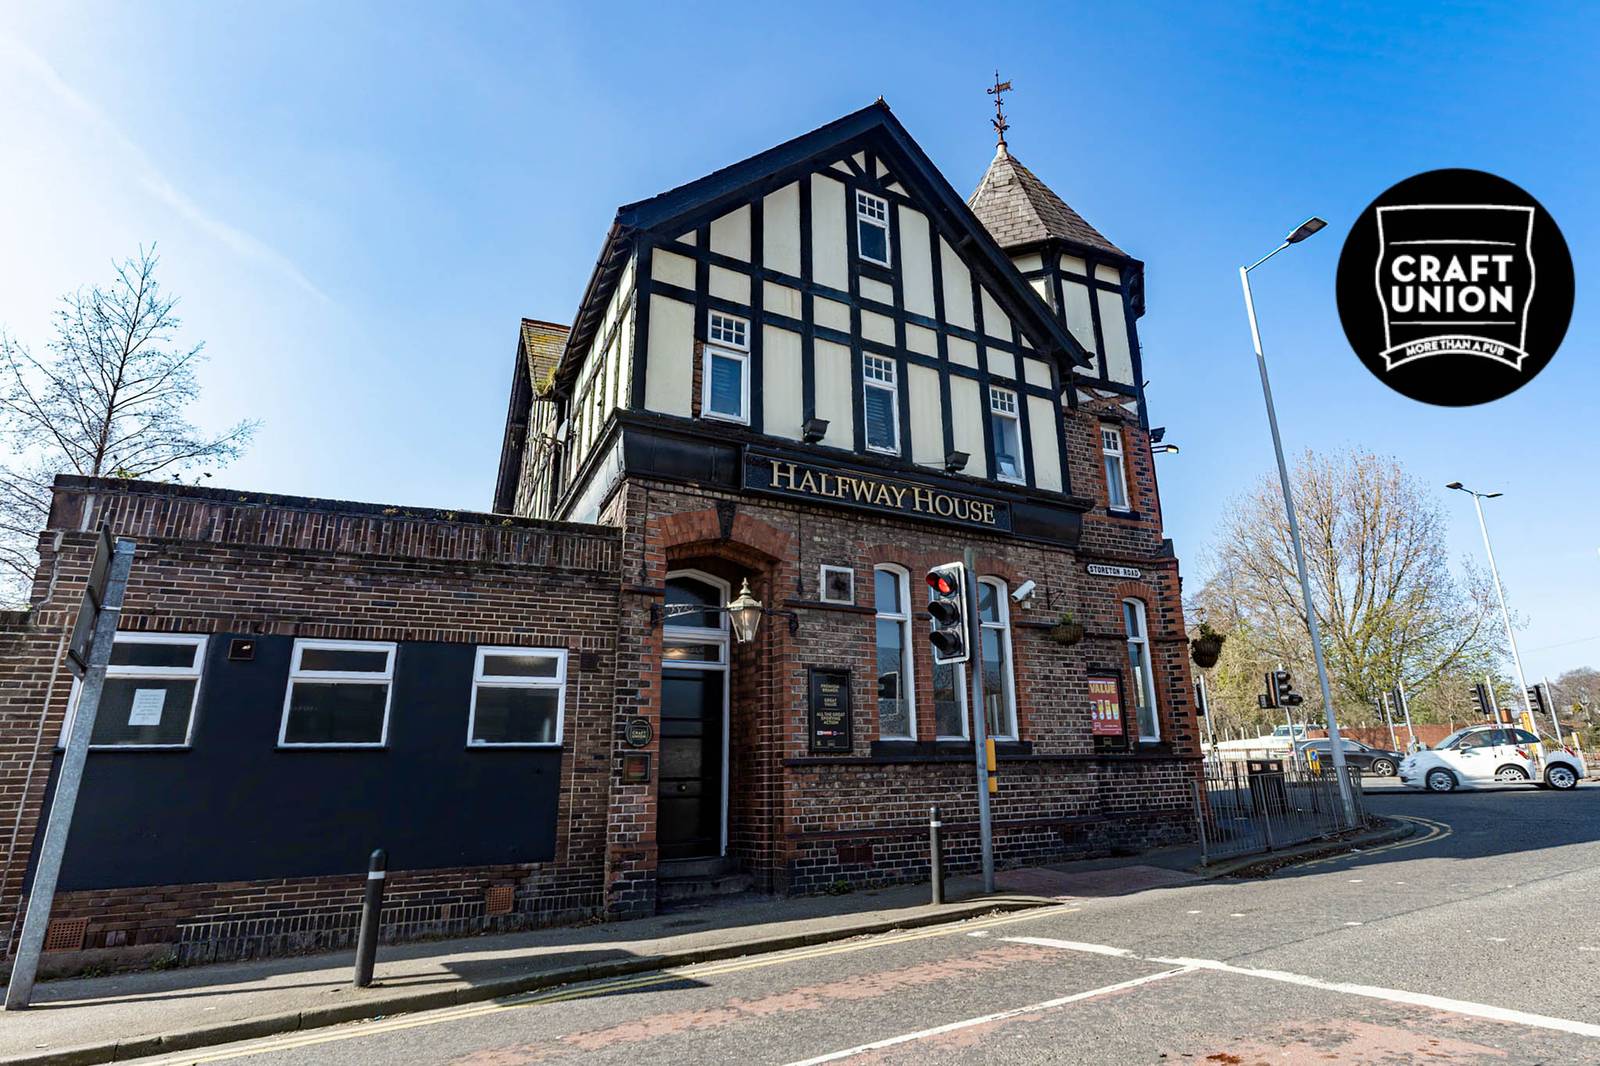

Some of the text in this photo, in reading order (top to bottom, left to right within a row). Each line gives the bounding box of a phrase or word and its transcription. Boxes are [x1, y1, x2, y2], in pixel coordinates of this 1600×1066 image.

[769, 460, 996, 524] HALFWAY HOUSE
[1090, 565, 1139, 577] STORETON ROAD
[1090, 683, 1117, 694] VALUE
